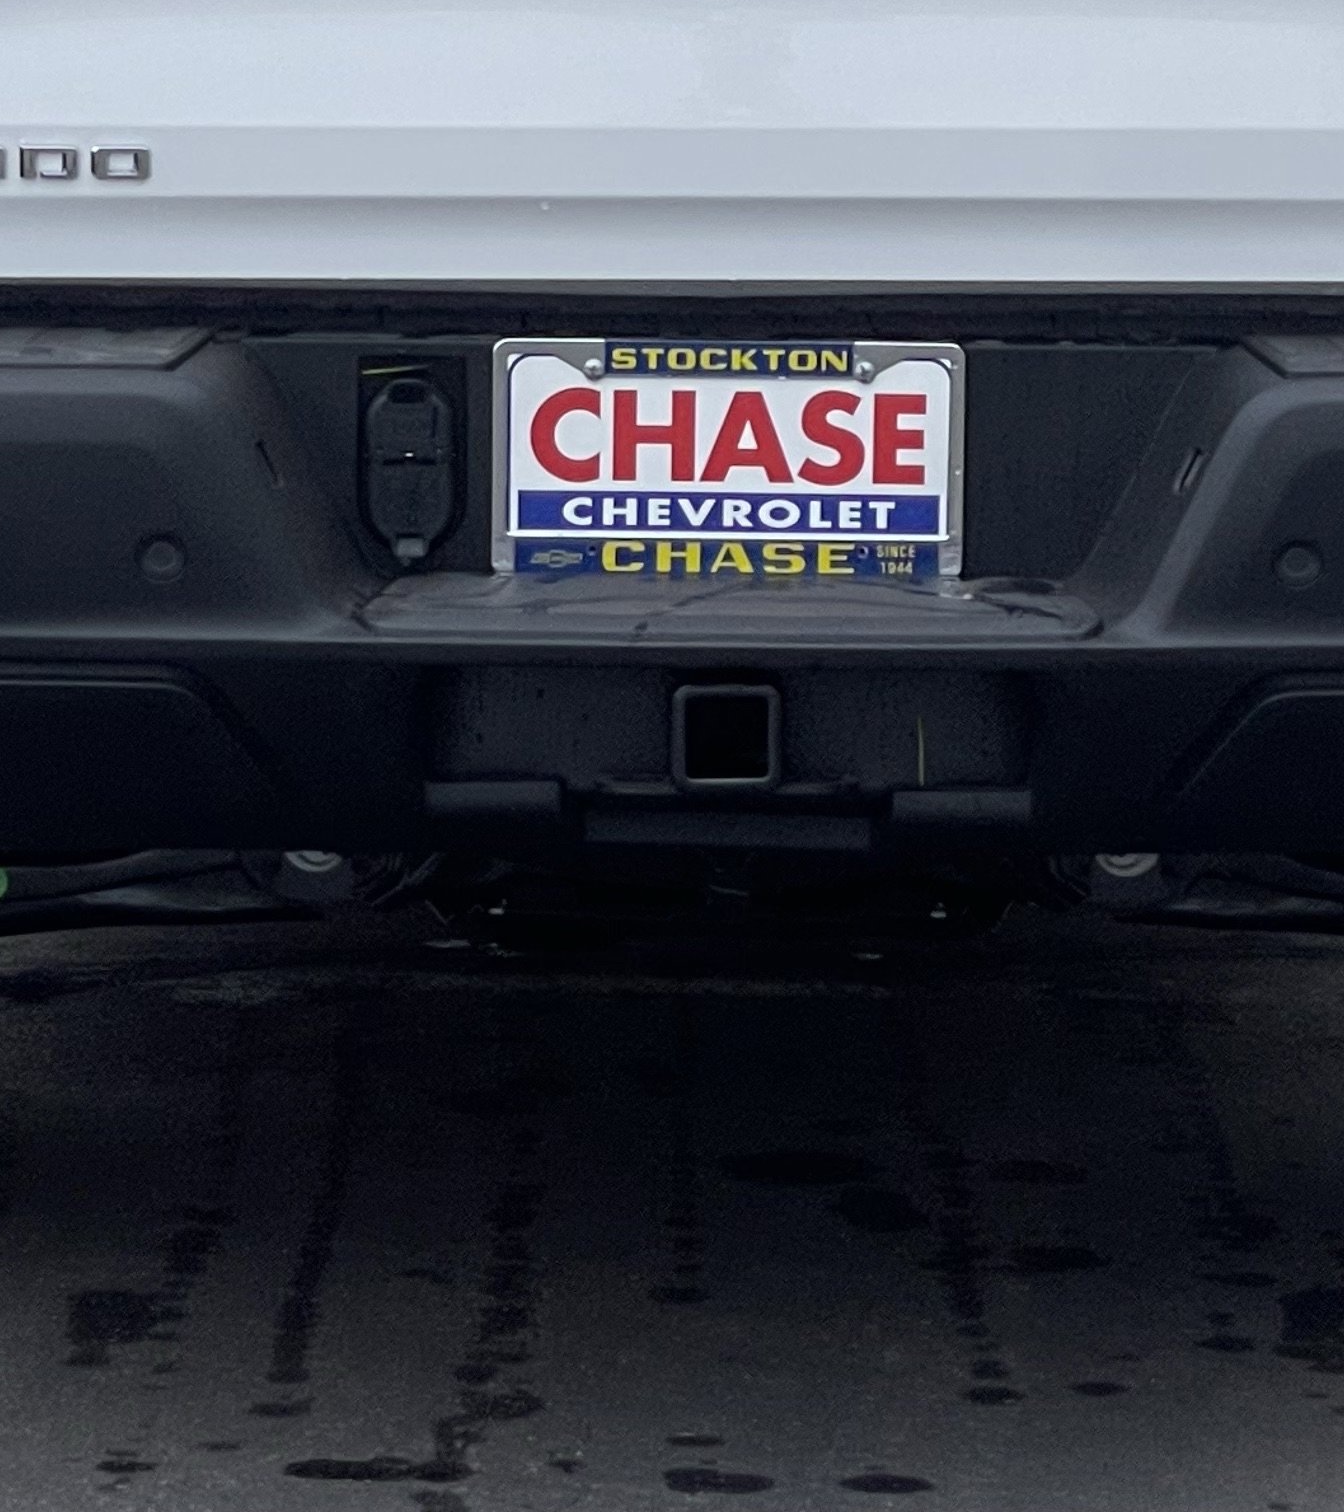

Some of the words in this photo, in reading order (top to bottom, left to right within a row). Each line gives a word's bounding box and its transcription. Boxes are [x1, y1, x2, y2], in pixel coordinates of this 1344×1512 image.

[611, 348, 848, 372] STOCKTON
[530, 387, 927, 486] CHASE
[562, 496, 895, 529] CHEVROLET
[600, 540, 856, 575] CHASE
[877, 545, 916, 558] SINCE
